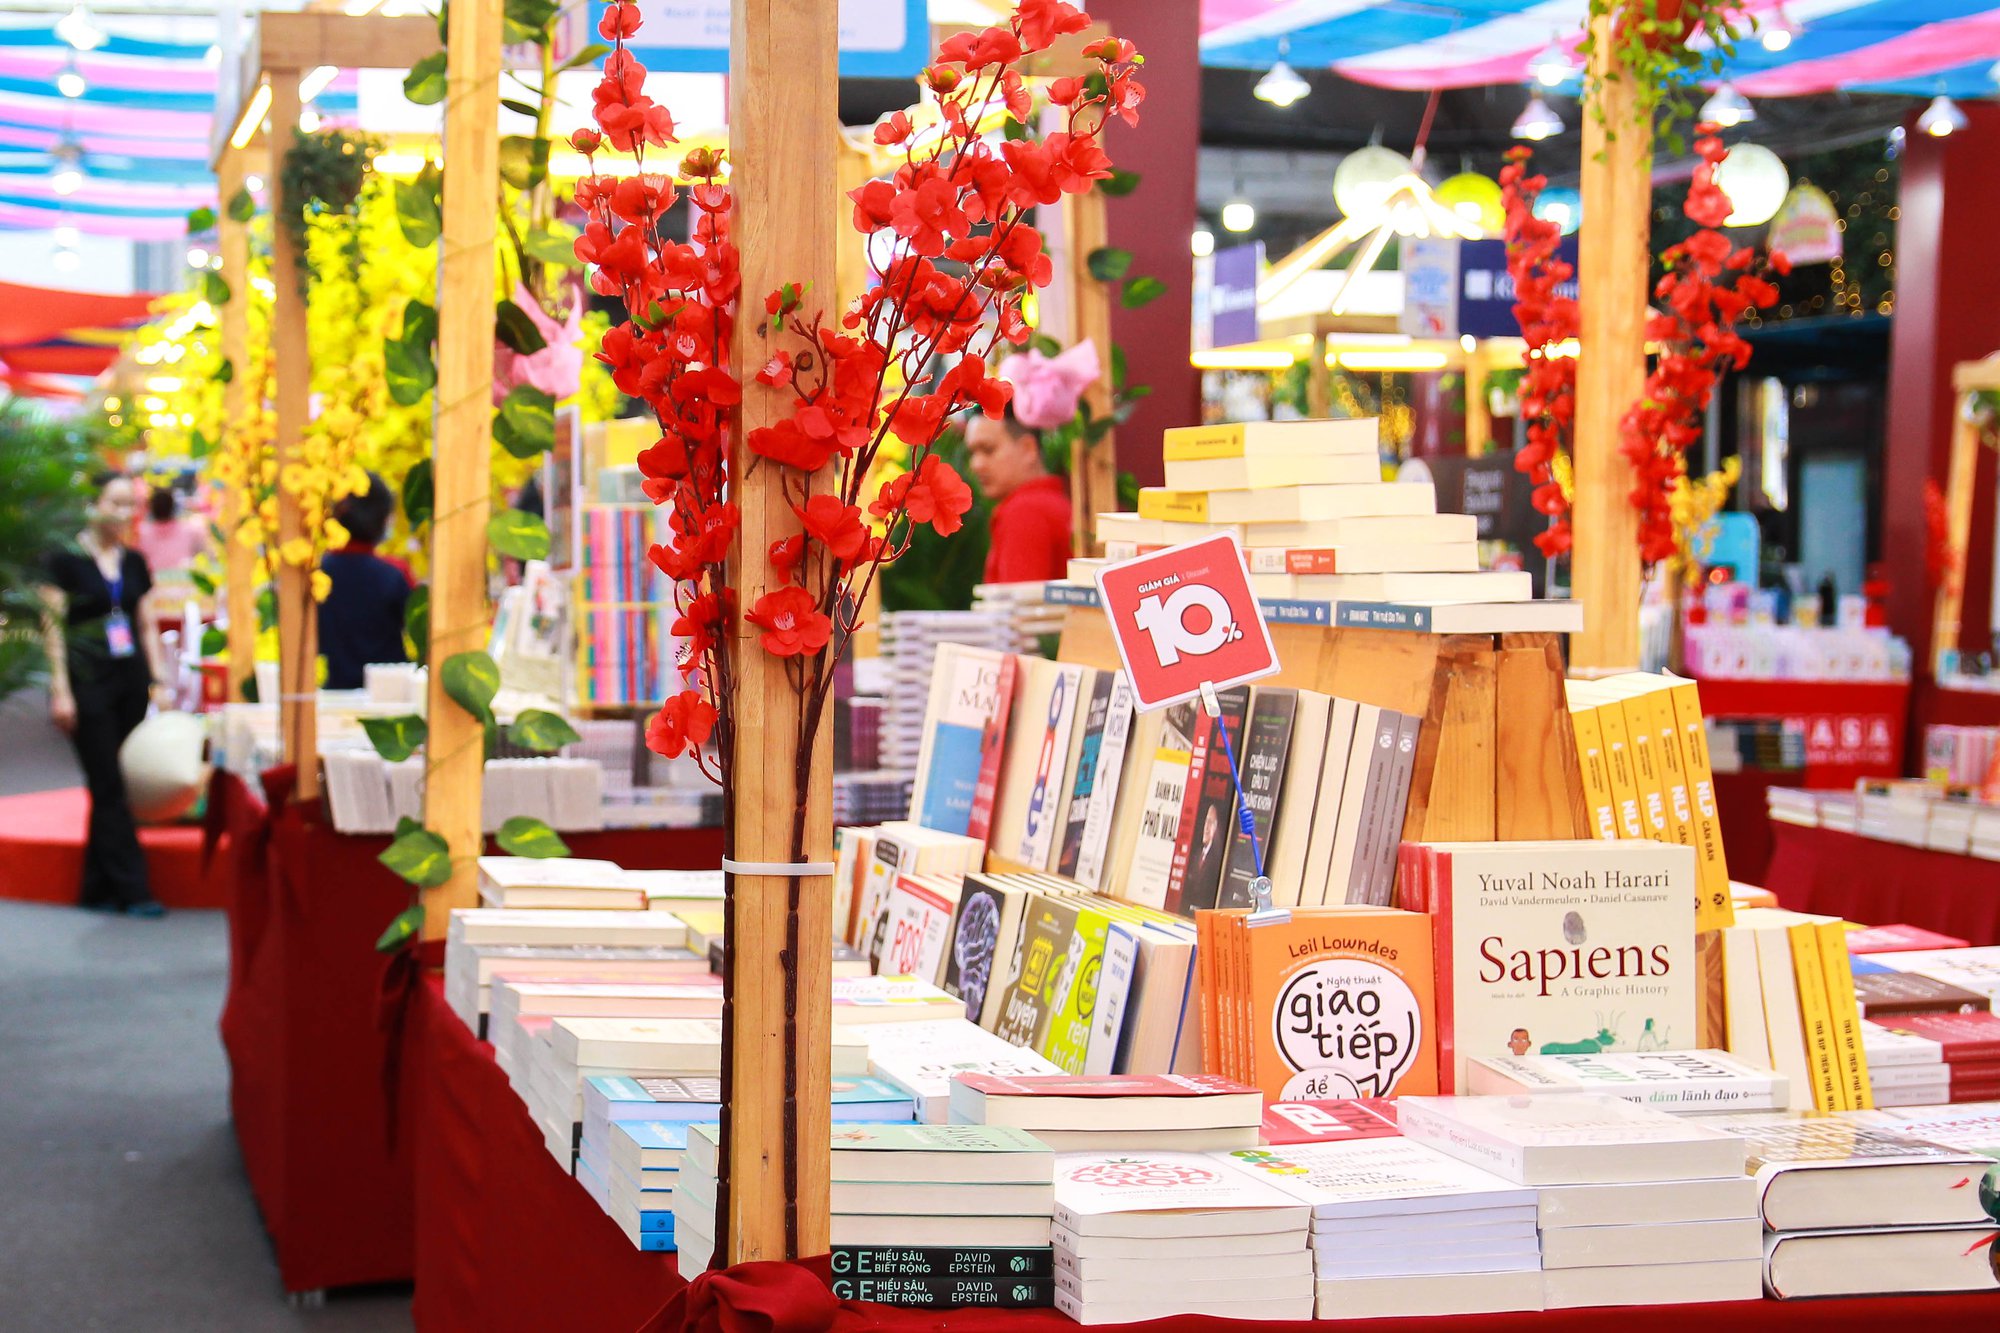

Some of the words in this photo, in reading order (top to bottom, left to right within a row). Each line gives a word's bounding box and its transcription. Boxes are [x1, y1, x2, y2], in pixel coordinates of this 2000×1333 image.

[1163, 572, 1181, 586] GIÁ
[1671, 785, 1689, 823] NLP
[1696, 780, 1714, 818] NLP
[1622, 799, 1640, 837] NLP
[1647, 792, 1665, 830] NLP
[1478, 871, 1533, 892] Yuval
[1542, 871, 1596, 890] Noah
[1605, 870, 1670, 889] Harari
[1480, 896, 1508, 907] David
[1512, 895, 1581, 906] Vandermeulen
[1590, 893, 1622, 904] Daniel
[1624, 893, 1669, 903] Casanave
[1288, 937, 1318, 959] Leil
[1322, 936, 1399, 961] Lowndes
[1479, 936, 1670, 997] Sapiens
[1326, 976, 1351, 989] Nghệ
[1353, 974, 1383, 986] thuật
[1561, 986, 1570, 997] A
[1574, 985, 1621, 1001] Graphic
[1625, 983, 1670, 998] History
[1290, 982, 1381, 1034] giao
[1311, 1020, 1398, 1070] tiếp
[1305, 1074, 1329, 1095] để
[1649, 1091, 1679, 1103] dám
[1682, 1089, 1711, 1102] lãnh
[1715, 1088, 1740, 1103] đạo
[1269, 1103, 1353, 1135] TED
[874, 1248, 899, 1262] HIỂU
[902, 1250, 926, 1263] SÂU,
[955, 1252, 991, 1263] DAVID
[874, 1259, 898, 1273] BIẾT
[900, 1261, 932, 1275] RỘNG
[949, 1263, 996, 1274] EPSTEIN
[877, 1277, 901, 1291] HIỂU
[903, 1279, 928, 1292] SÂU,
[957, 1281, 993, 1292] DAVID
[876, 1288, 899, 1303] BIẾT
[902, 1290, 934, 1304] RỘNG
[951, 1292, 998, 1303] EPSTEIN
